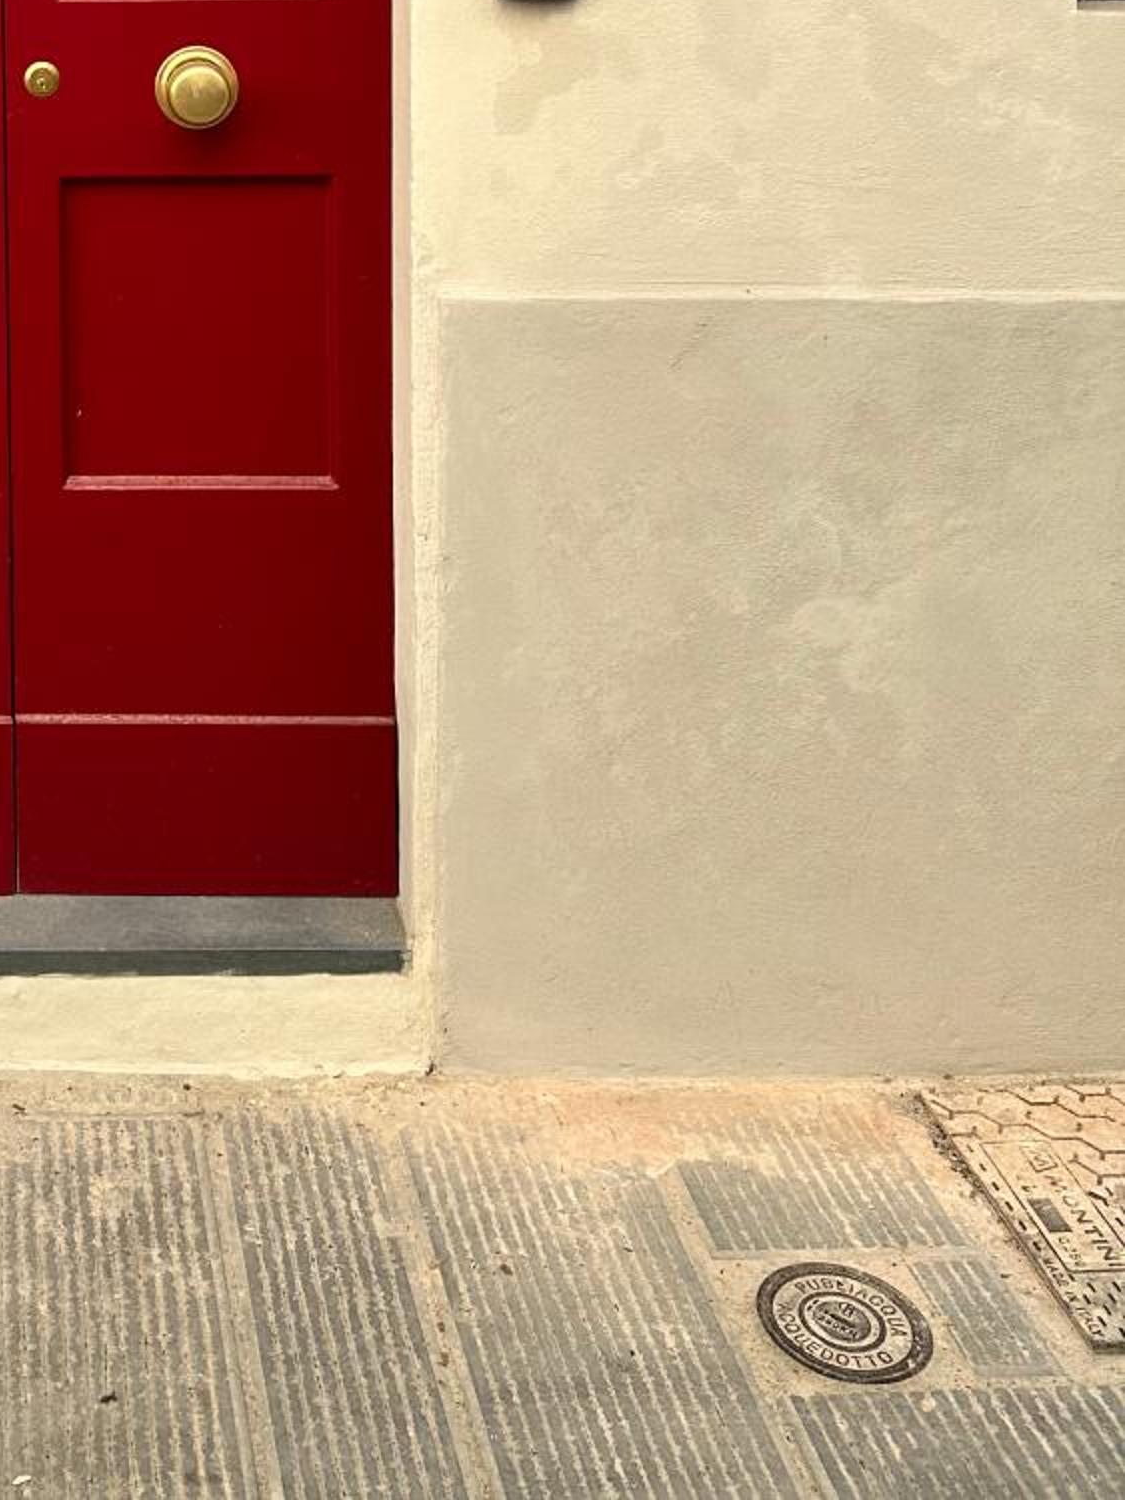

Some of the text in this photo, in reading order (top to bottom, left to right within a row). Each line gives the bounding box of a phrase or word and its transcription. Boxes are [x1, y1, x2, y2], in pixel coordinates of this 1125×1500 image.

[1044, 1175, 1125, 1267] MONTINI
[777, 1301, 894, 1369] ACQUEDOTTO
[794, 1277, 908, 1338] PUBLIACQUA
